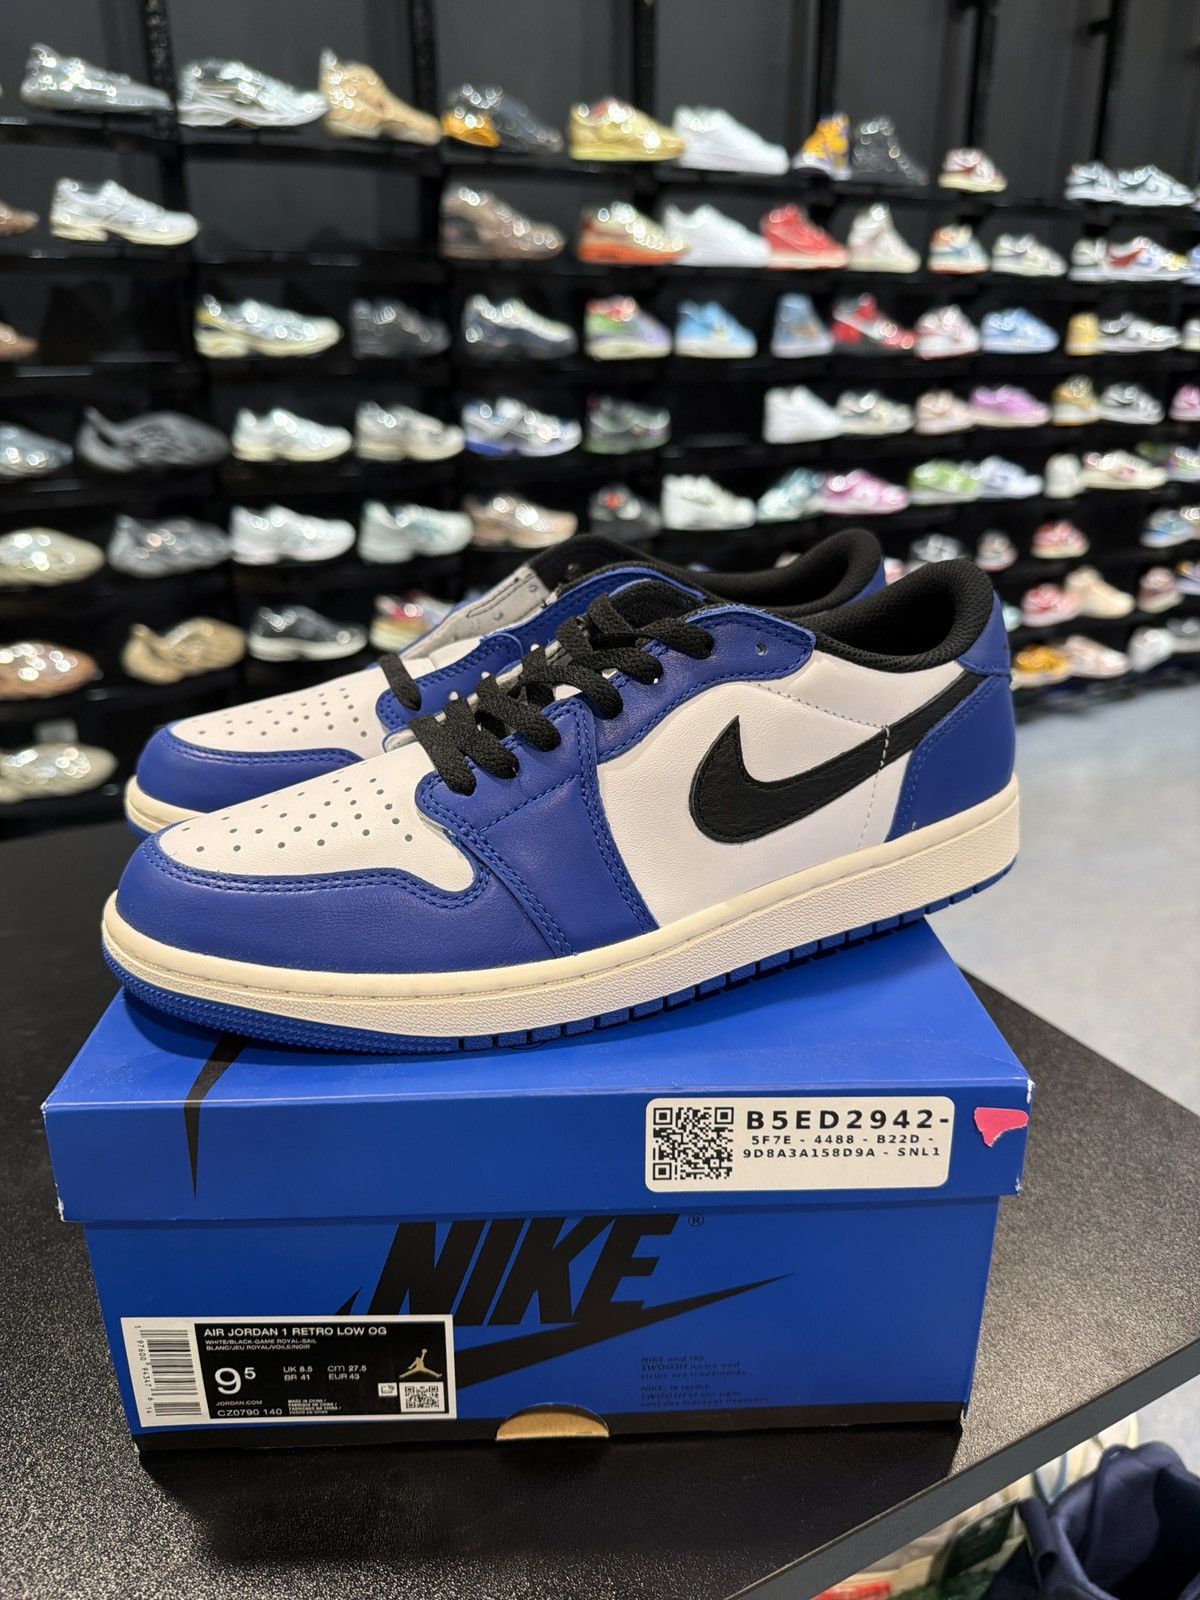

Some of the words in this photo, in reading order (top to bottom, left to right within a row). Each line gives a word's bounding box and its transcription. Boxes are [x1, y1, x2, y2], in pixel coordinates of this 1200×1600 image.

[747, 1109, 949, 1130] B5ED2942-
[751, 1135, 792, 1145] 5F7E
[814, 1134, 855, 1144] 4488
[877, 1134, 919, 1144] B22D
[897, 1147, 940, 1157] SNL1
[367, 1213, 680, 1326] NIKE
[204, 1328, 225, 1337] AIR
[228, 1328, 278, 1337] JORDAN
[282, 1328, 288, 1336] 1
[292, 1327, 333, 1336] RETRO
[337, 1327, 364, 1336] LOW
[368, 1326, 387, 1335] OG
[214, 1367, 242, 1395] 9
[244, 1367, 256, 1380] 5
[217, 1409, 260, 1417] CZ0790
[263, 1408, 283, 1416] 140
